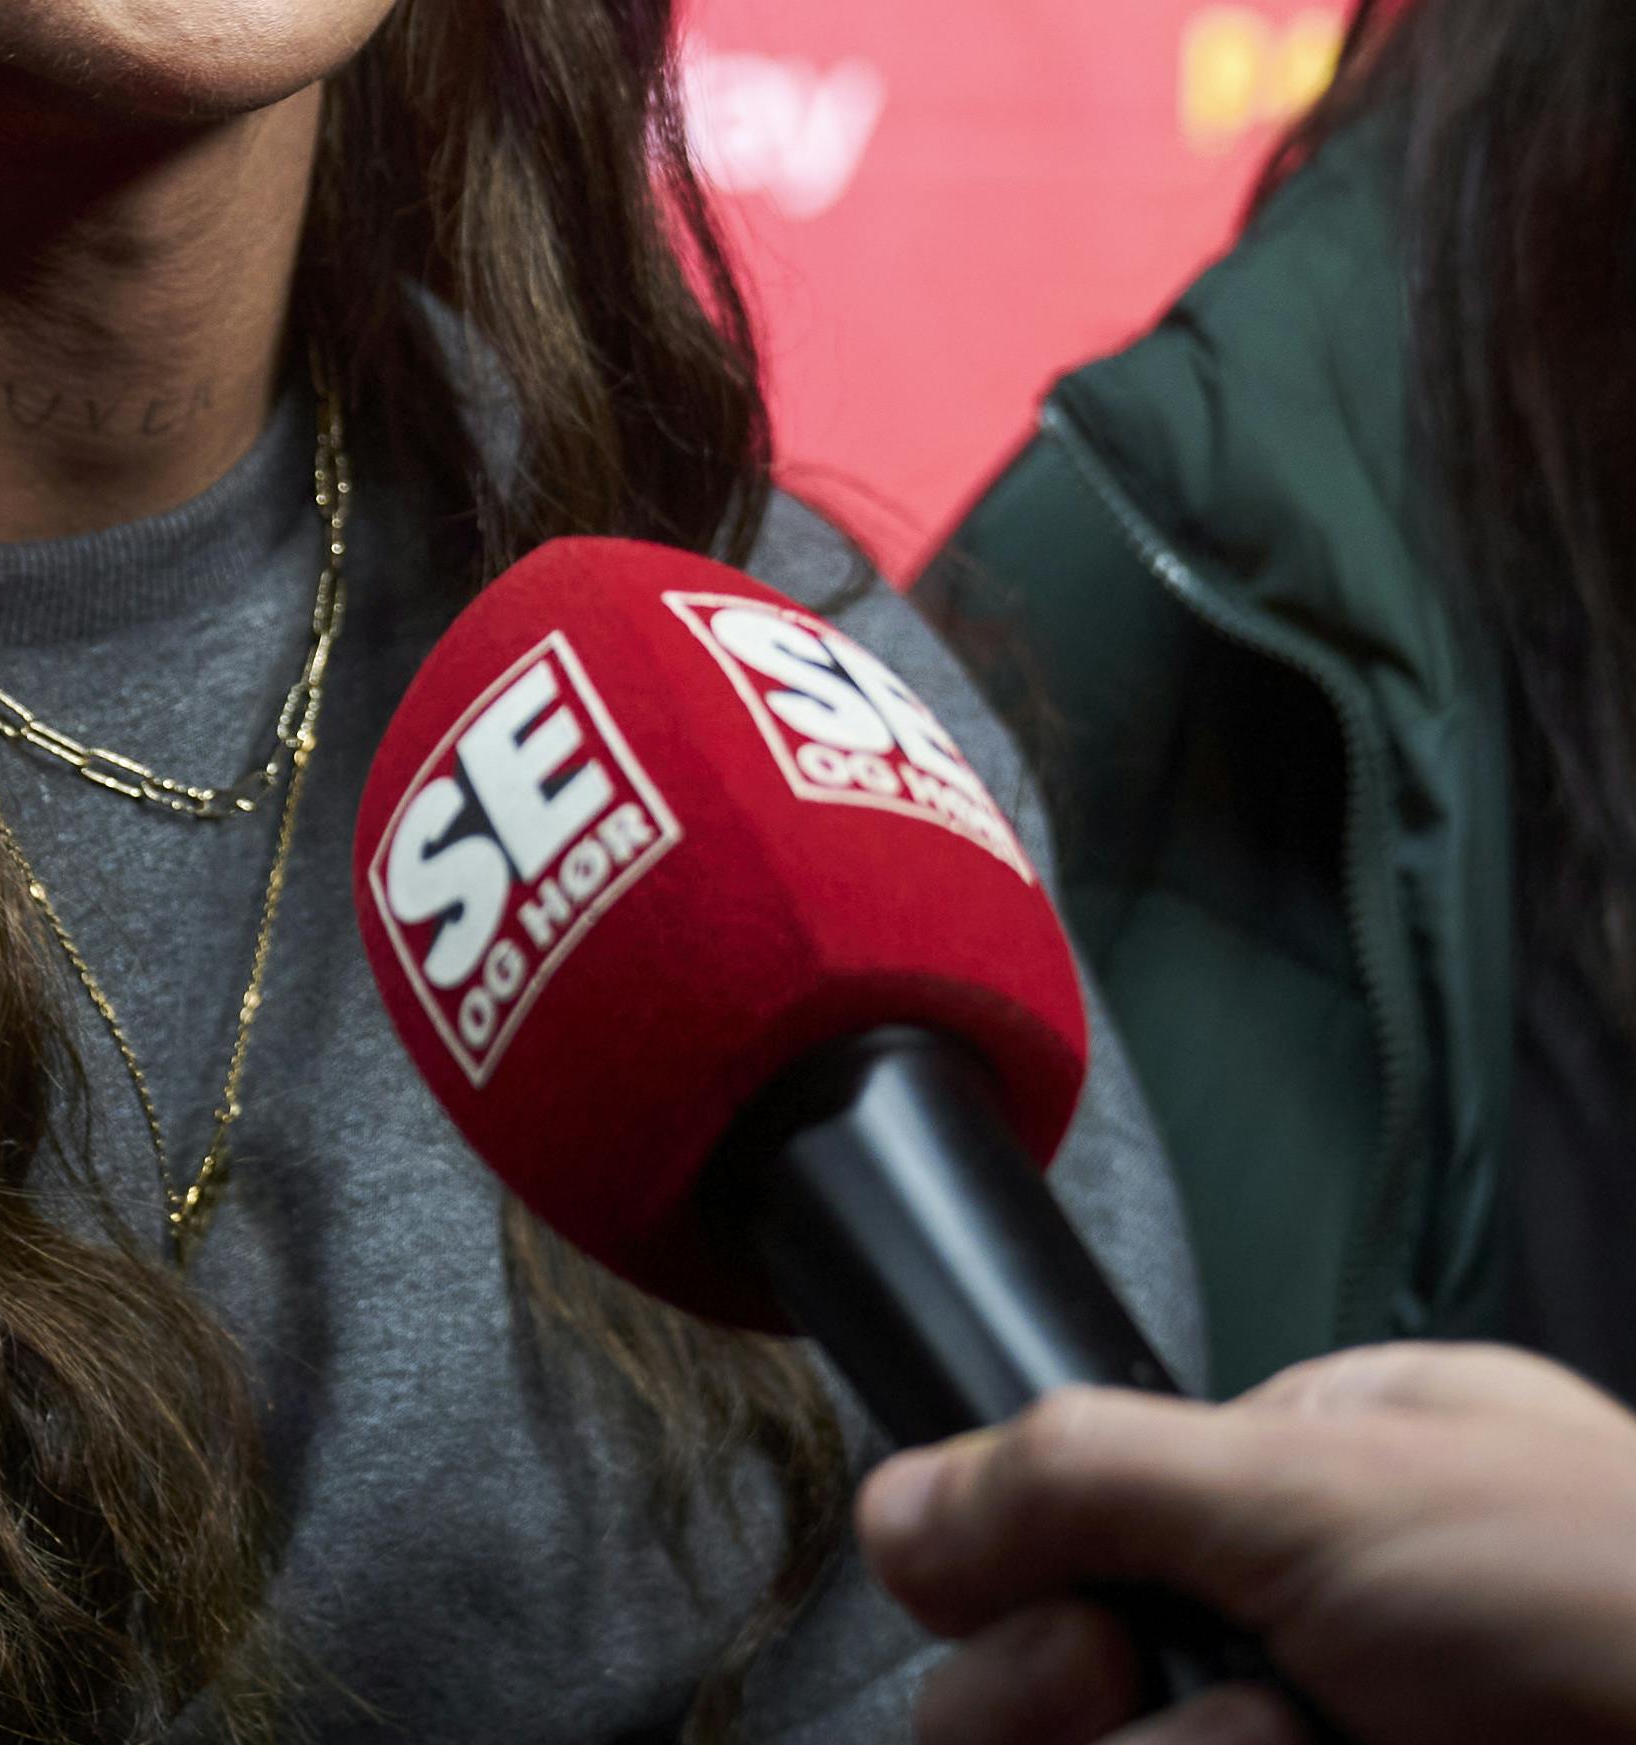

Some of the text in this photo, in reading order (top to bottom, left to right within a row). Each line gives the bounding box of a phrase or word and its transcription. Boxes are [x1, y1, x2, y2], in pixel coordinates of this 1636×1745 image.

[387, 659, 615, 991] SE
[796, 742, 903, 798] OG
[458, 802, 654, 1048] OG HØR
